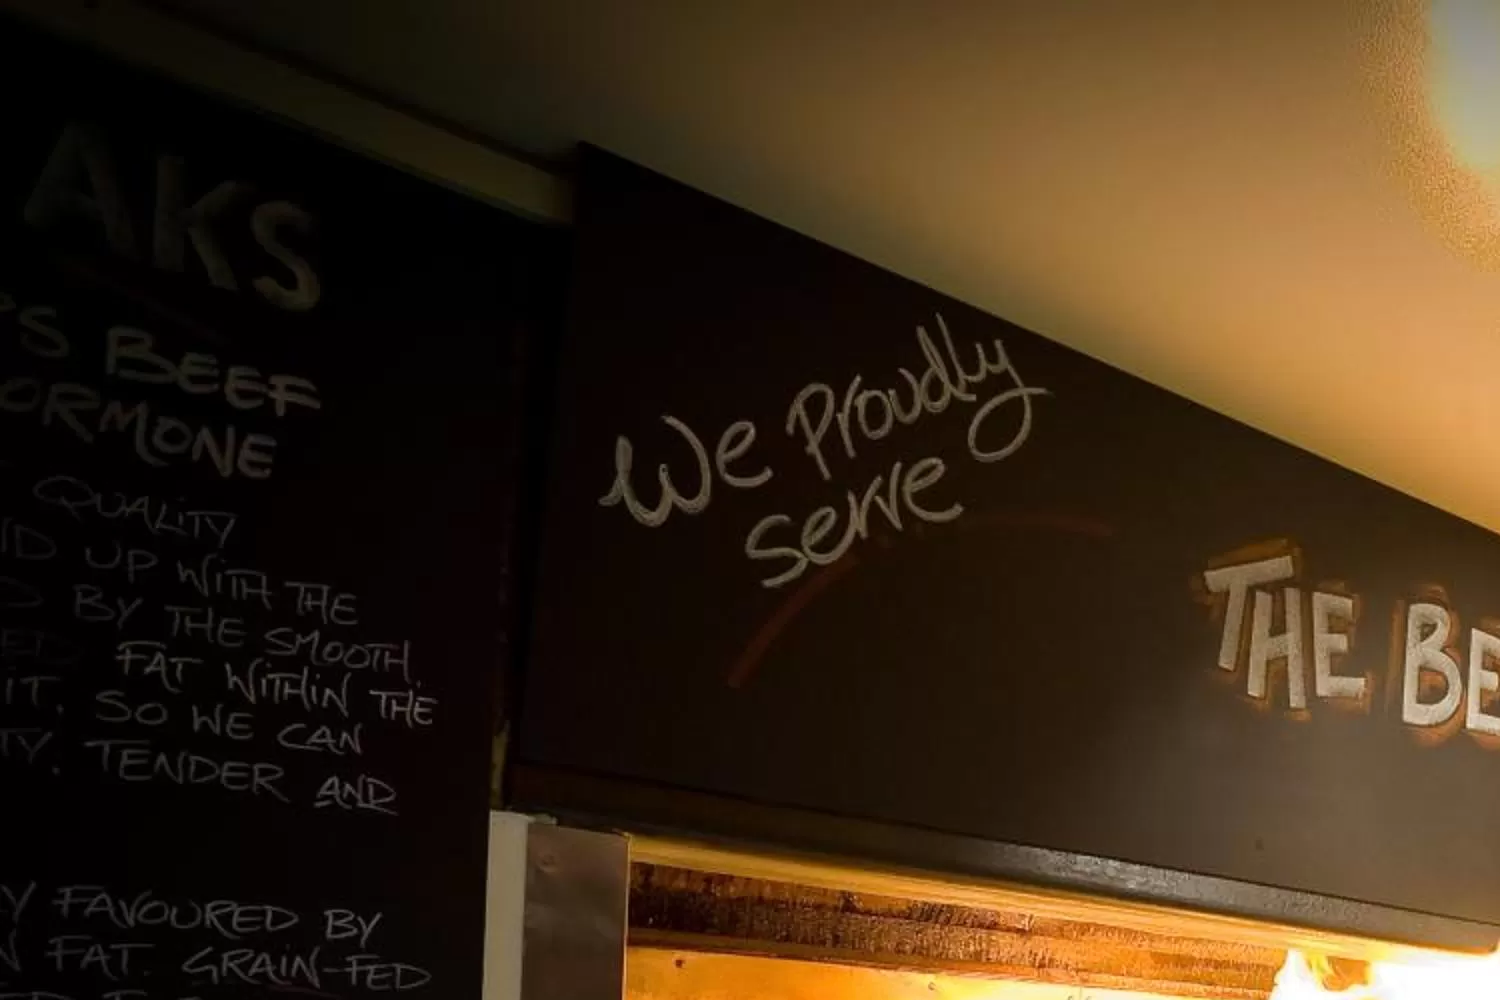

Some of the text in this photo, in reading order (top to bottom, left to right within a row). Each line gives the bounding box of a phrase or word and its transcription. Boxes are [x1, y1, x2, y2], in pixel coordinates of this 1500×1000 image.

[24, 118, 322, 314] AKS
[0, 290, 322, 418] S BEEF
[598, 313, 1052, 528] We Proudly
[72, 583, 144, 630] BY
[164, 604, 248, 648] THE
[84, 539, 160, 582] UP
[284, 580, 358, 626] THE
[1204, 555, 1368, 710] THE
[95, 689, 168, 727] SO
[192, 703, 256, 741] WE
[277, 722, 364, 756] CAN
[114, 640, 204, 696] FAT
[368, 688, 438, 730] THE
[81, 737, 290, 803] TENDER
[313, 775, 399, 815] AND
[0, 879, 383, 948] Y FAVOURED BY
